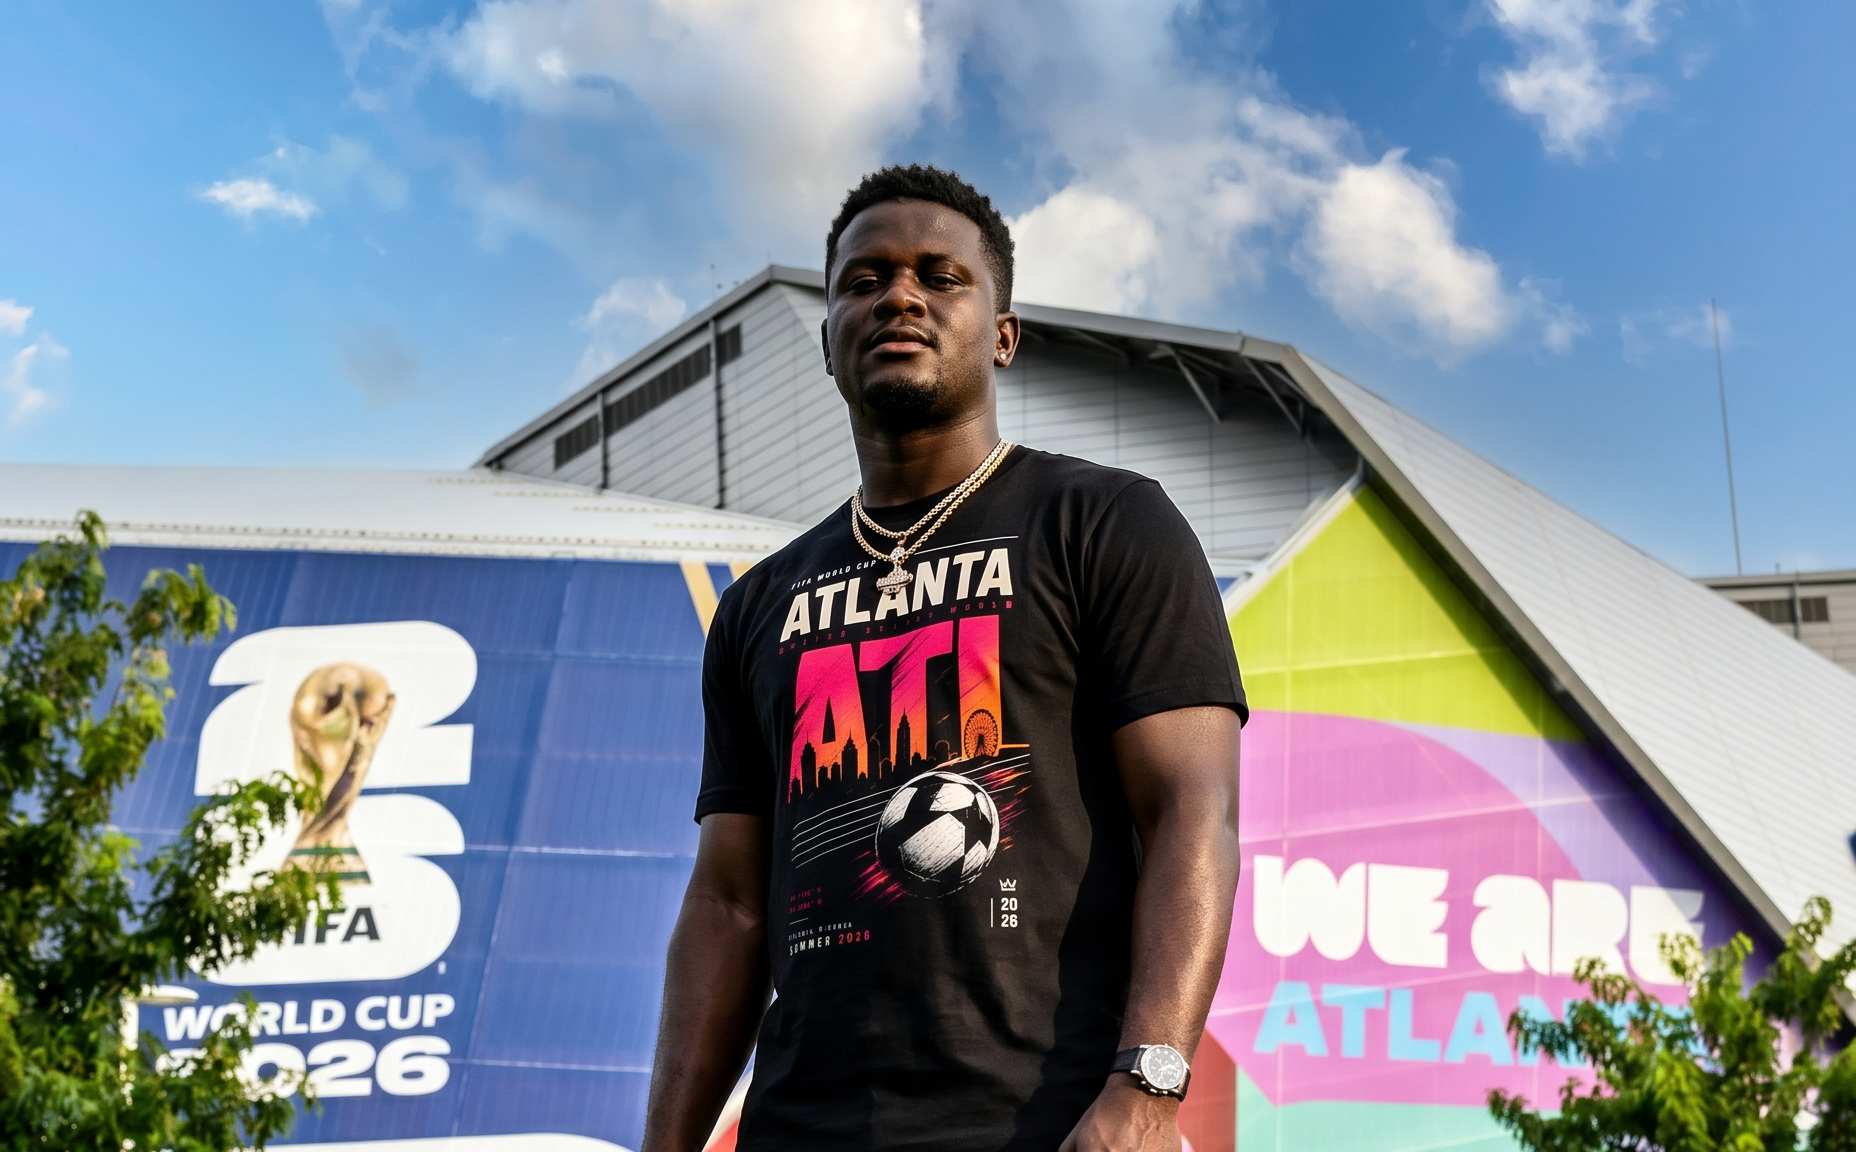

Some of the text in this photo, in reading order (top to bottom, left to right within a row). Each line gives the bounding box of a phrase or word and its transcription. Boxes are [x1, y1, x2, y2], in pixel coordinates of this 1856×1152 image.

[856, 559, 878, 571] CUP
[779, 547, 1014, 643] ATLANTA
[1000, 897, 1018, 911] 20
[1000, 913, 1018, 928] 26
[1253, 854, 1450, 969] WE
[284, 906, 381, 945] IFA
[838, 930, 870, 945] 2026
[163, 993, 456, 1042] WORLD CUP
[1253, 980, 1702, 1070] ATLAN
